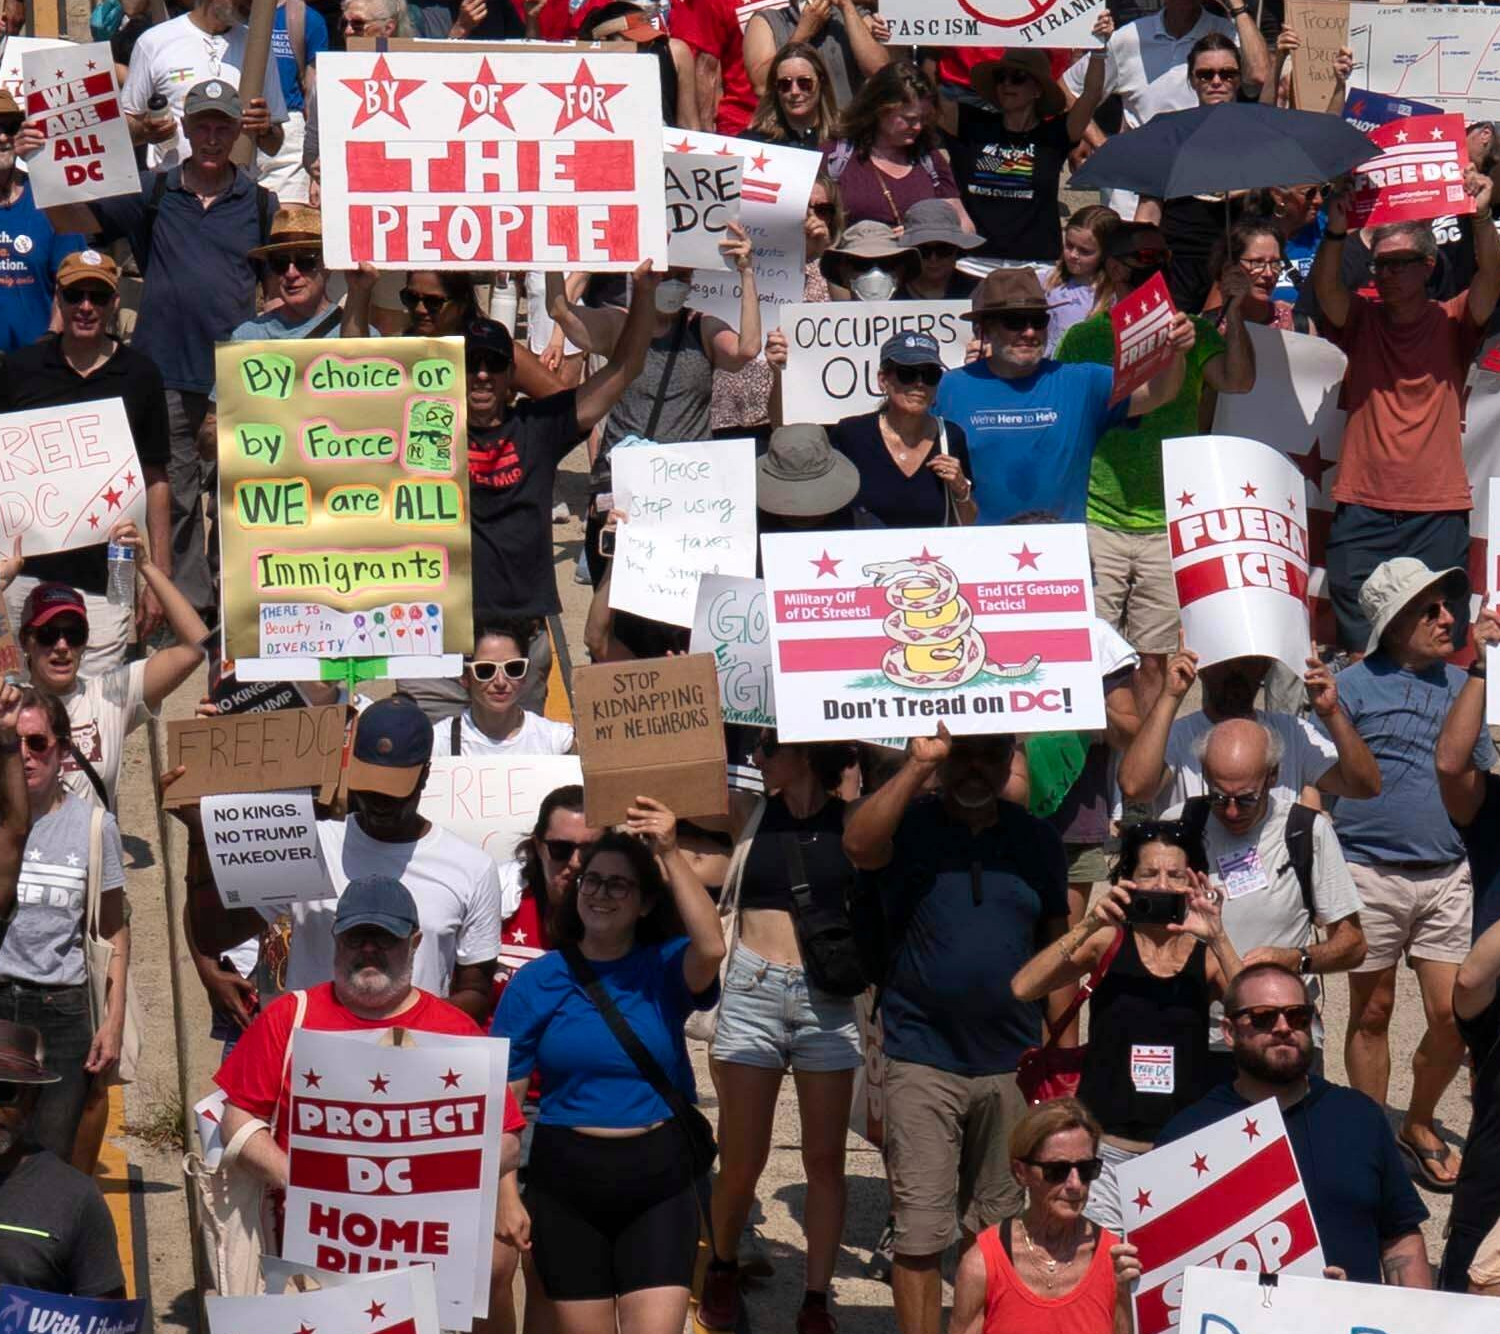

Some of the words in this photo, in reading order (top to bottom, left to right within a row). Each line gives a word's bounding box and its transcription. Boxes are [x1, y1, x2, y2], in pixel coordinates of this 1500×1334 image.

[886, 19, 982, 39] FASCISM
[361, 79, 400, 116] BY
[470, 84, 501, 115] OF
[564, 82, 610, 121] FOR
[401, 142, 577, 193] THE
[370, 205, 611, 261] PEOPLE
[242, 360, 293, 396] By
[310, 362, 401, 392] choice
[417, 365, 453, 390] or
[242, 432, 283, 466] by
[307, 427, 394, 459] Force
[240, 485, 306, 526] WE
[330, 494, 378, 514] are
[394, 485, 460, 523] ALL
[259, 554, 441, 591] Immigrants
[784, 594, 838, 608] Military
[838, 591, 858, 604] Off
[977, 586, 1002, 599] End
[1004, 586, 1024, 599] ICE
[1026, 584, 1080, 601] Gestapo
[978, 600, 1027, 613] Tactics!
[786, 609, 799, 622] of
[801, 608, 820, 622] DC
[821, 606, 872, 620] Streets!
[613, 671, 659, 693] STOP
[593, 685, 703, 720] KIDNAPPING
[822, 698, 890, 722] Don't
[892, 697, 968, 718] Tread
[973, 696, 1005, 715] on
[1009, 688, 1075, 716] DC!
[596, 725, 612, 739] MY
[625, 708, 709, 739] NEIGHBORS
